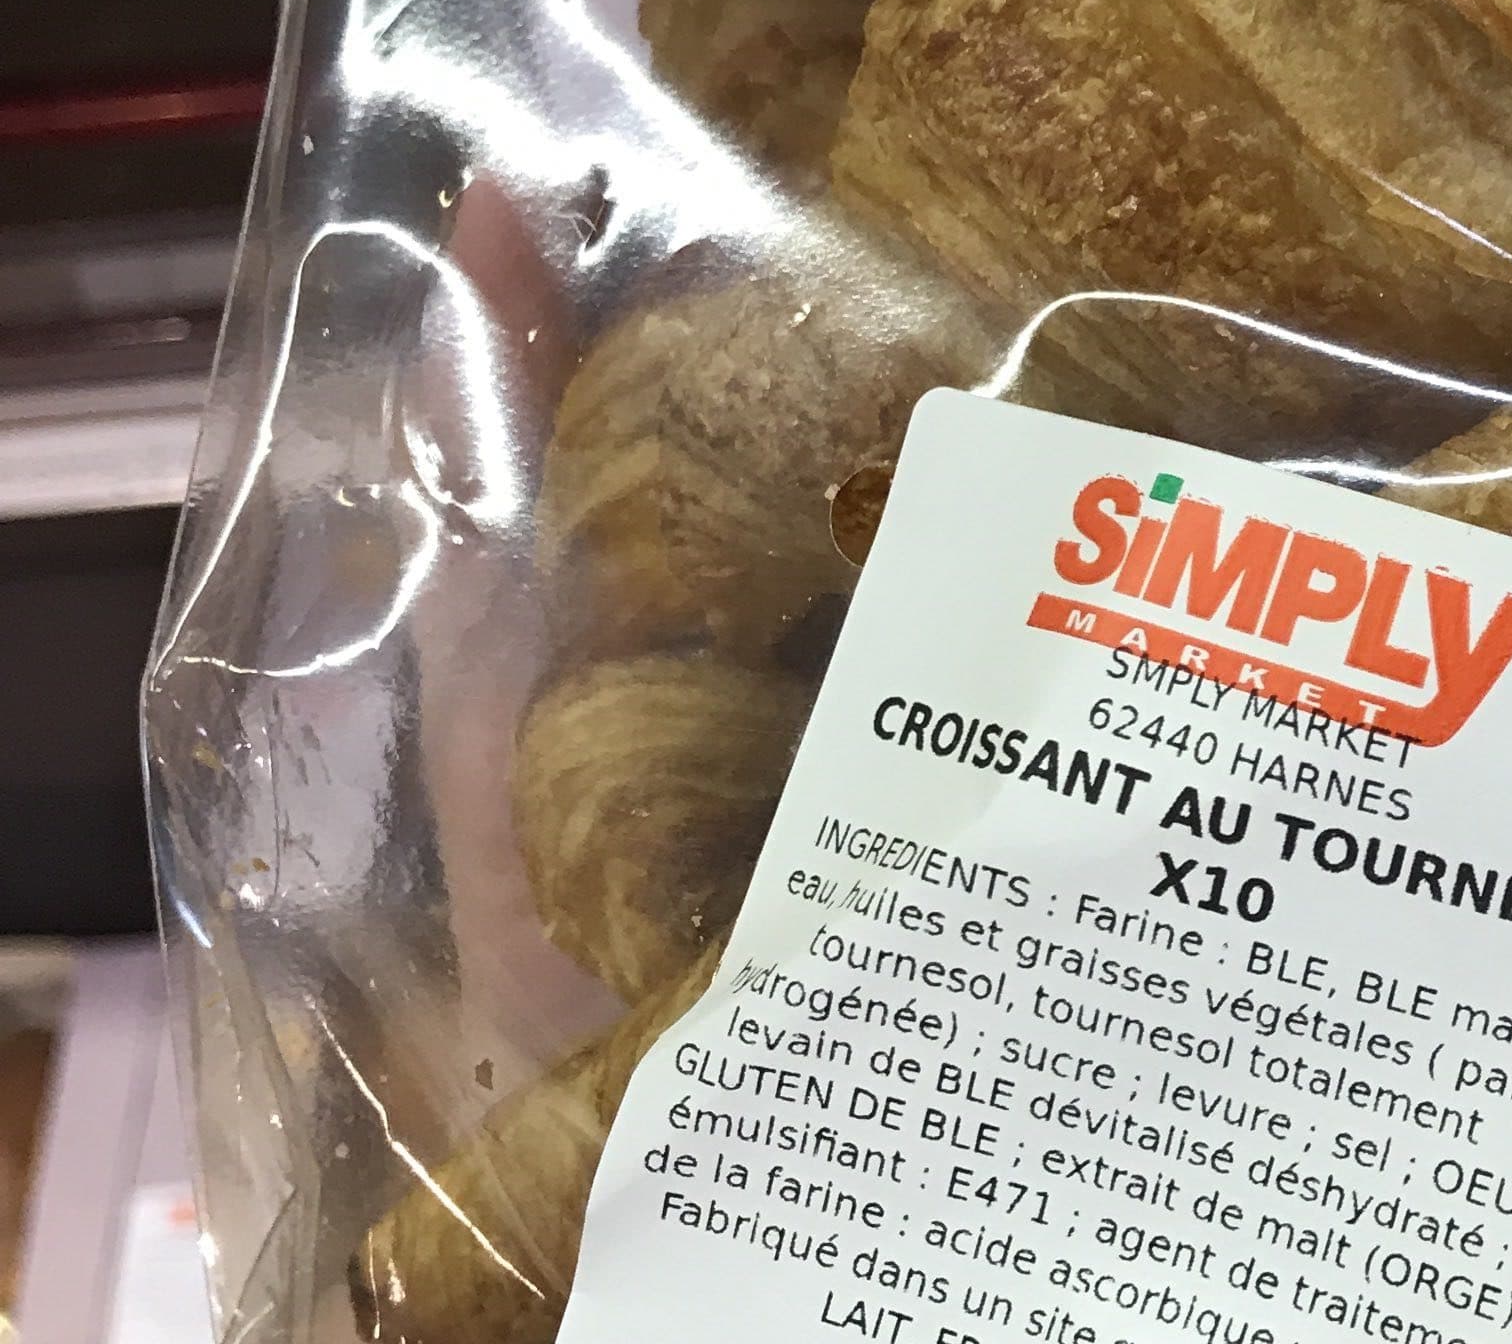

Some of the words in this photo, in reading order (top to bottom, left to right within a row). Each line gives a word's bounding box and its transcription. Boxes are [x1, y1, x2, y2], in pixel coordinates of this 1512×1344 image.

[1064, 609, 1387, 725] MARKET
[1106, 646, 1236, 712] SMPLY
[1242, 687, 1421, 768] MARKET
[872, 696, 1153, 816] CROISSANT
[1158, 785, 1253, 846] AU
[1088, 697, 1219, 766] 62440
[1229, 742, 1413, 821] HARNES
[814, 815, 1031, 908] INGREDIENTS
[1046, 894, 1057, 917] :
[1075, 893, 1204, 957] Farine
[1218, 942, 1229, 965] :
[1246, 940, 1336, 999] BLE,
[1355, 969, 1439, 1021] BLE
[1148, 851, 1275, 924] X10
[730, 957, 958, 1050] hydrogénée)
[972, 1030, 985, 1058] ;
[999, 1037, 1116, 1090] sucre
[1128, 1074, 1141, 1102] ;
[1158, 1071, 1292, 1141] levure
[1303, 1125, 1316, 1153] ;
[1331, 1132, 1392, 1173] sel
[1402, 1157, 1417, 1186] ;
[809, 924, 1014, 1014] tournesol,
[1033, 984, 1235, 1069] tournesol
[1249, 1044, 1485, 1146] totalement
[960, 919, 1004, 953] et
[1015, 935, 1191, 1005] graisses
[1205, 987, 1414, 1066] végétales
[1428, 1043, 1445, 1081] (
[643, 1143, 698, 1178] de
[713, 1152, 749, 1191] la
[765, 1165, 885, 1230] farine
[898, 1214, 910, 1237] :
[924, 1220, 1037, 1276] acide
[667, 1094, 907, 1184] émulsifiant
[919, 1167, 930, 1190] :
[946, 1165, 1050, 1226] E471
[1066, 1210, 1080, 1238] ;
[1094, 1217, 1217, 1279] agent
[1227, 1256, 1280, 1300] de
[675, 1042, 835, 1110] GLUTEN
[848, 1086, 907, 1131] DE
[919, 1107, 1001, 1158] BLE
[1012, 1141, 1025, 1168] ;
[1041, 1149, 1181, 1212] extrait
[1192, 1190, 1244, 1232] de
[1256, 1214, 1352, 1270] malt
[727, 1005, 853, 1066] levain
[869, 1045, 922, 1085] de
[935, 1062, 1016, 1111] BLE
[1029, 1091, 1235, 1175] dévitalisé
[1247, 1155, 1485, 1258] déshydraté
[1495, 1243, 1509, 1271] ;
[660, 1191, 840, 1269] Fabriqué
[851, 1247, 950, 1304] dans
[962, 1286, 1013, 1326] un
